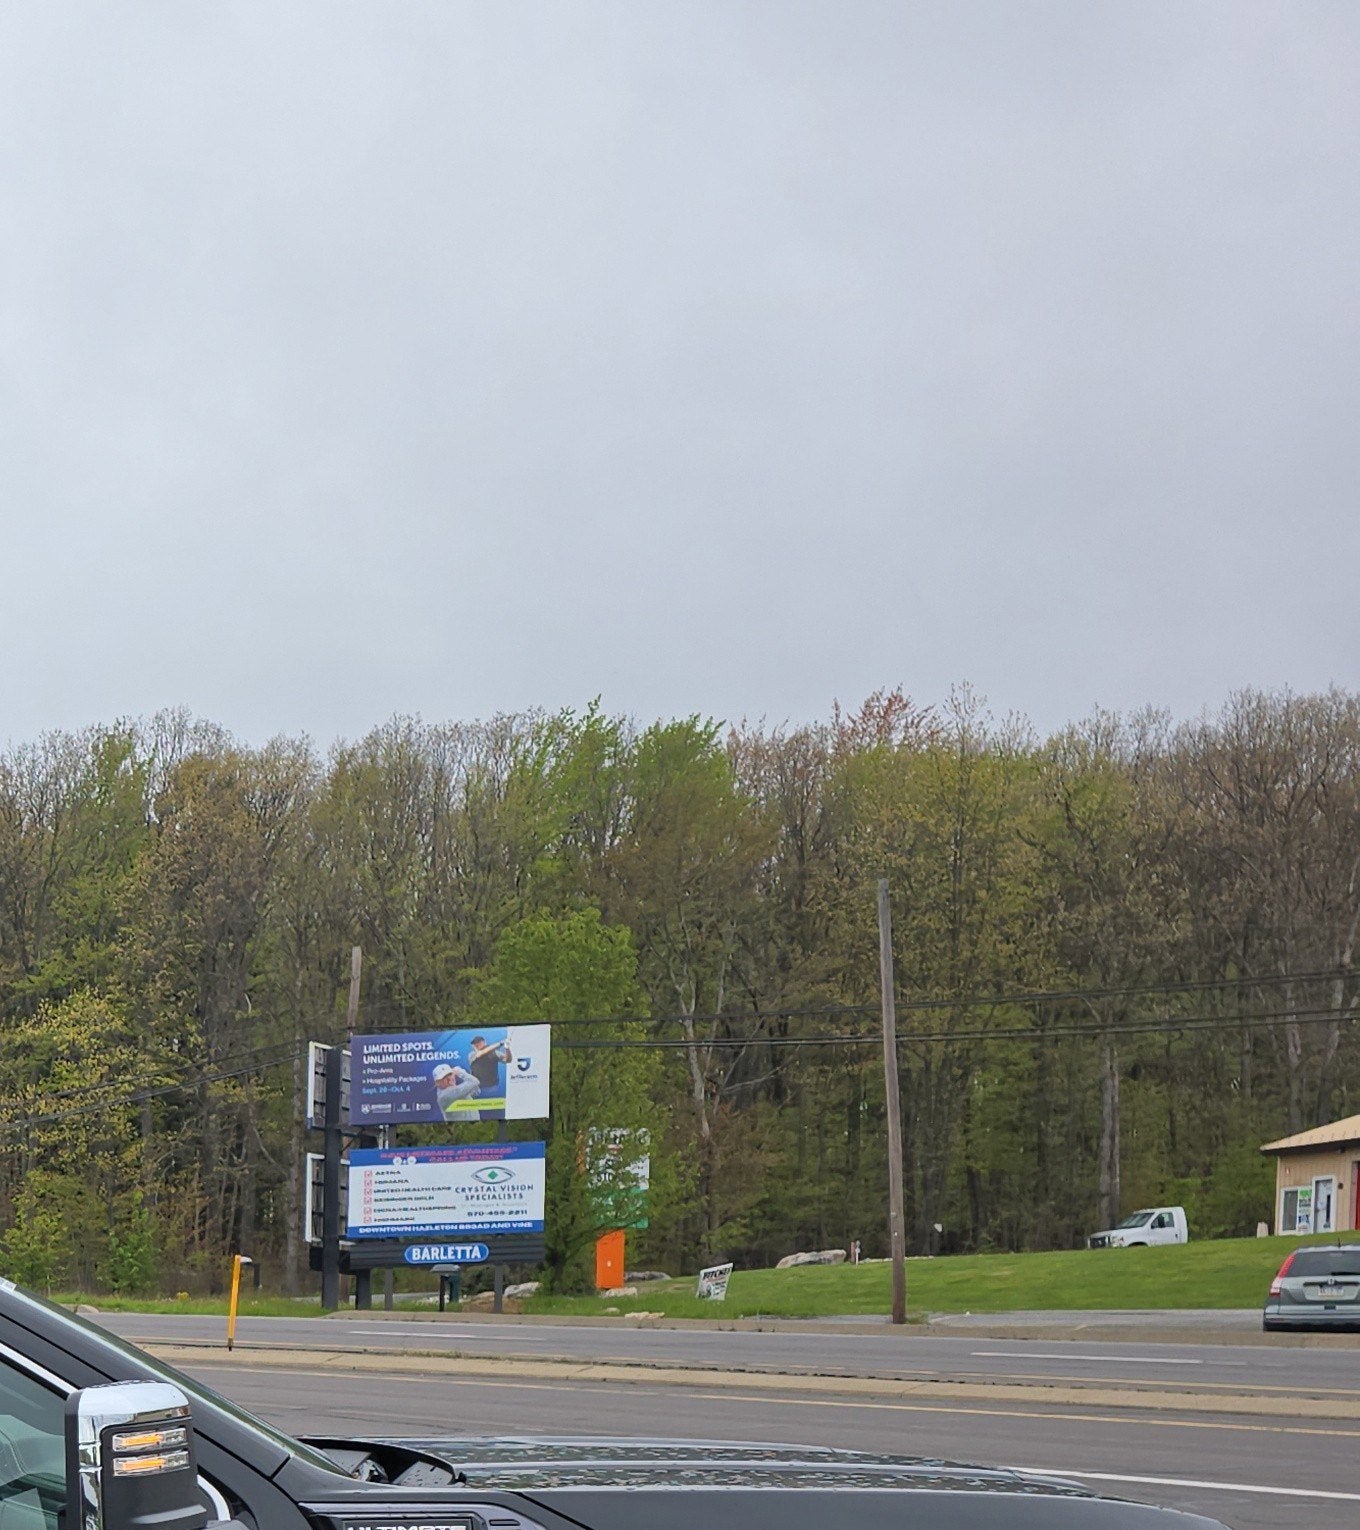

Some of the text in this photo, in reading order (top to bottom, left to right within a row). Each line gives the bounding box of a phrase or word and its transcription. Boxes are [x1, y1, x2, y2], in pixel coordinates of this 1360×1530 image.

[363, 1043, 400, 1055] LIMITED
[363, 1053, 414, 1064] UNLIMITED
[455, 1184, 534, 1194] CRYSTAL VISION
[465, 1193, 524, 1201] SPECIALISTS
[359, 1225, 411, 1234] DOWNTOWN
[411, 1244, 482, 1261] BARLETTA
